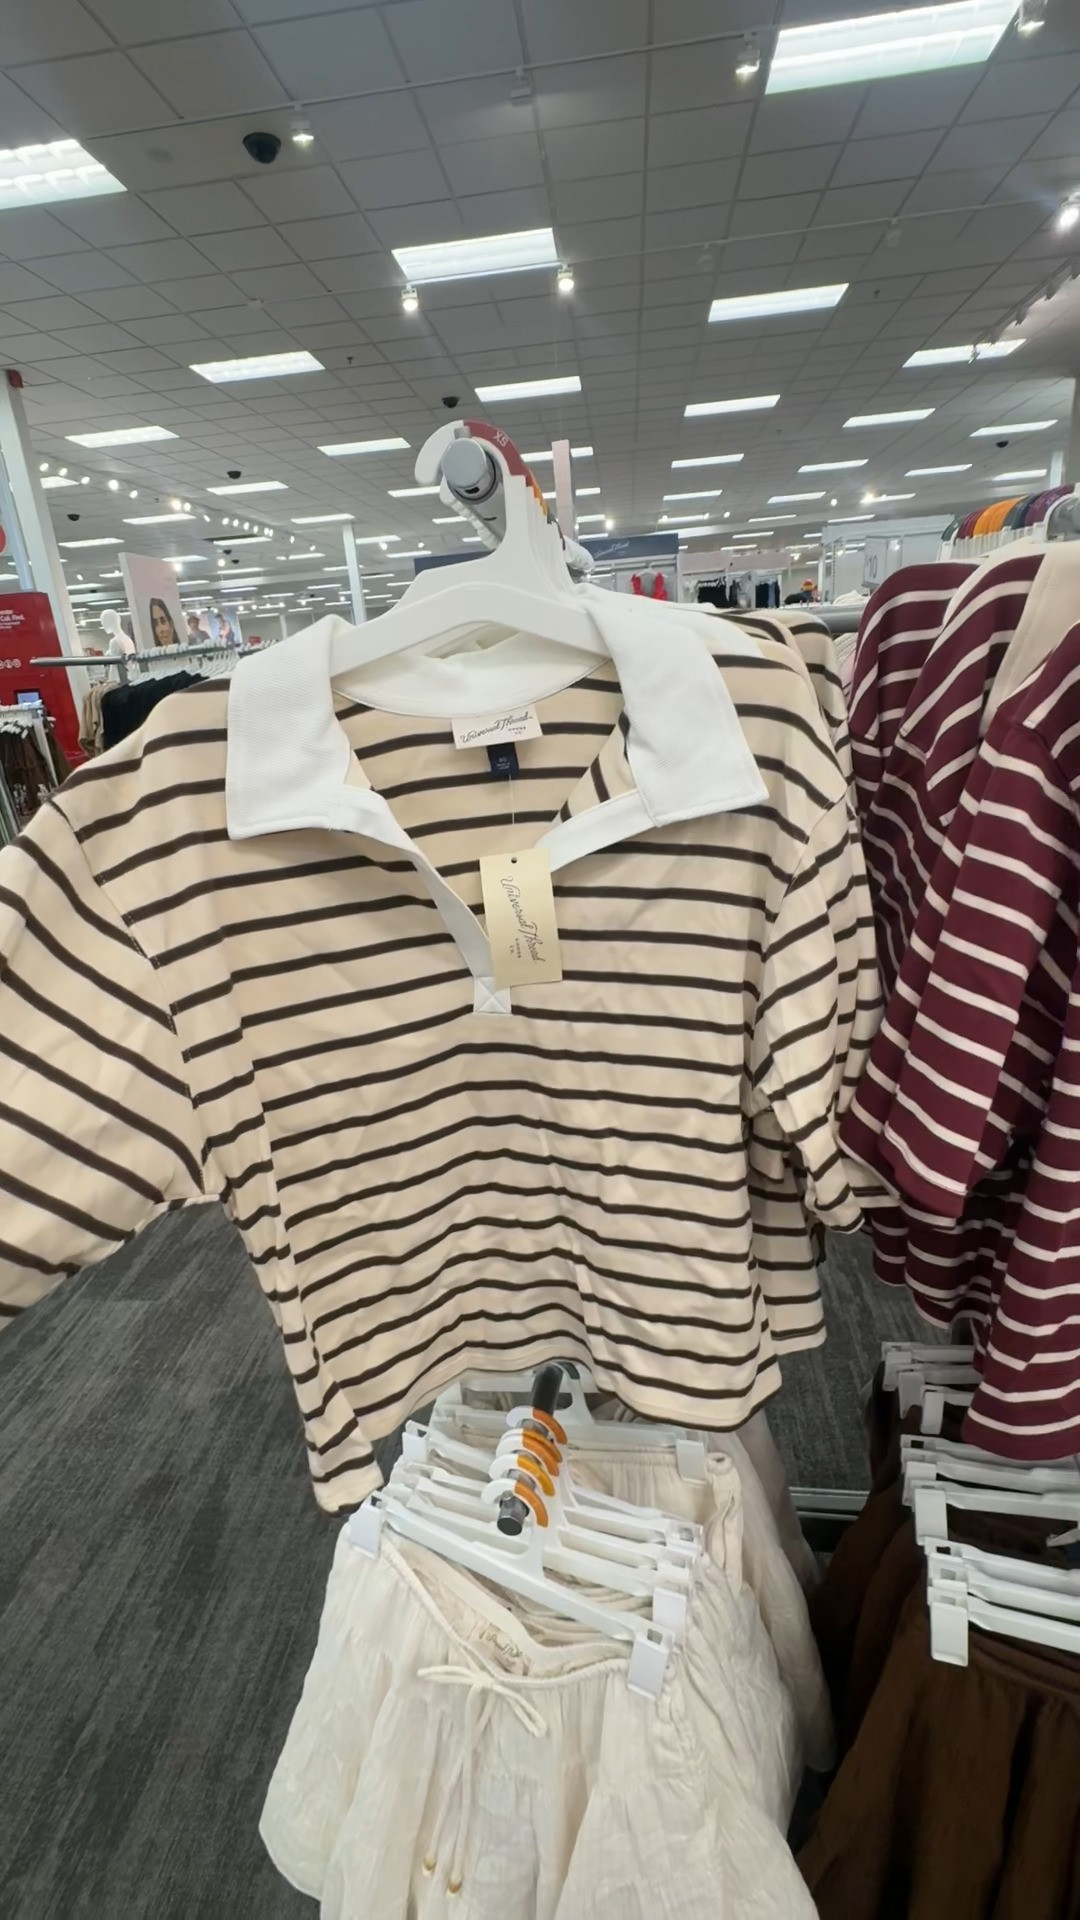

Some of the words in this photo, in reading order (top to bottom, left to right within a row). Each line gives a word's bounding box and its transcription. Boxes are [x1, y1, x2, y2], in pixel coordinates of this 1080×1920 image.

[492, 430, 508, 447] XS
[460, 720, 501, 743] Universal
[500, 711, 529, 731] Thread
[500, 875, 535, 930] Universal
[518, 921, 546, 962] Thread
